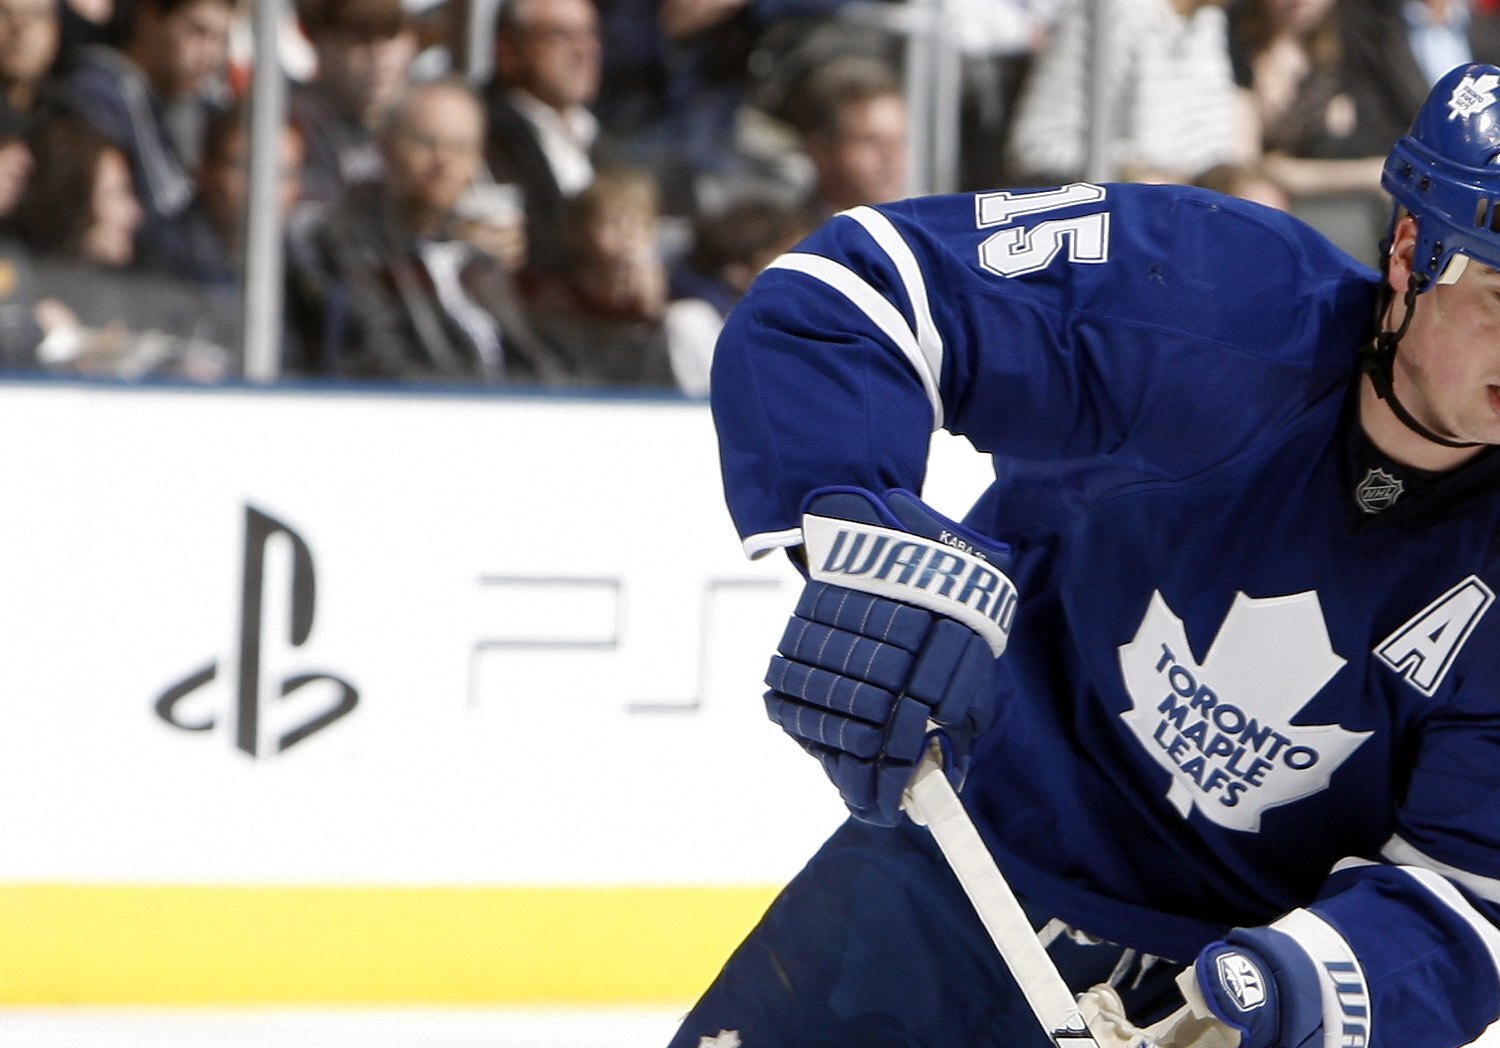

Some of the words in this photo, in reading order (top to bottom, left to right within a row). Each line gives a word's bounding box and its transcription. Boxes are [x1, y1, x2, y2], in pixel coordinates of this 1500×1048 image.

[975, 182, 1111, 278] 15
[1371, 574, 1497, 697] A
[1155, 642, 1320, 771] TORONTO
[1156, 692, 1274, 787] MAPLE
[1152, 719, 1249, 808] LEAFS
